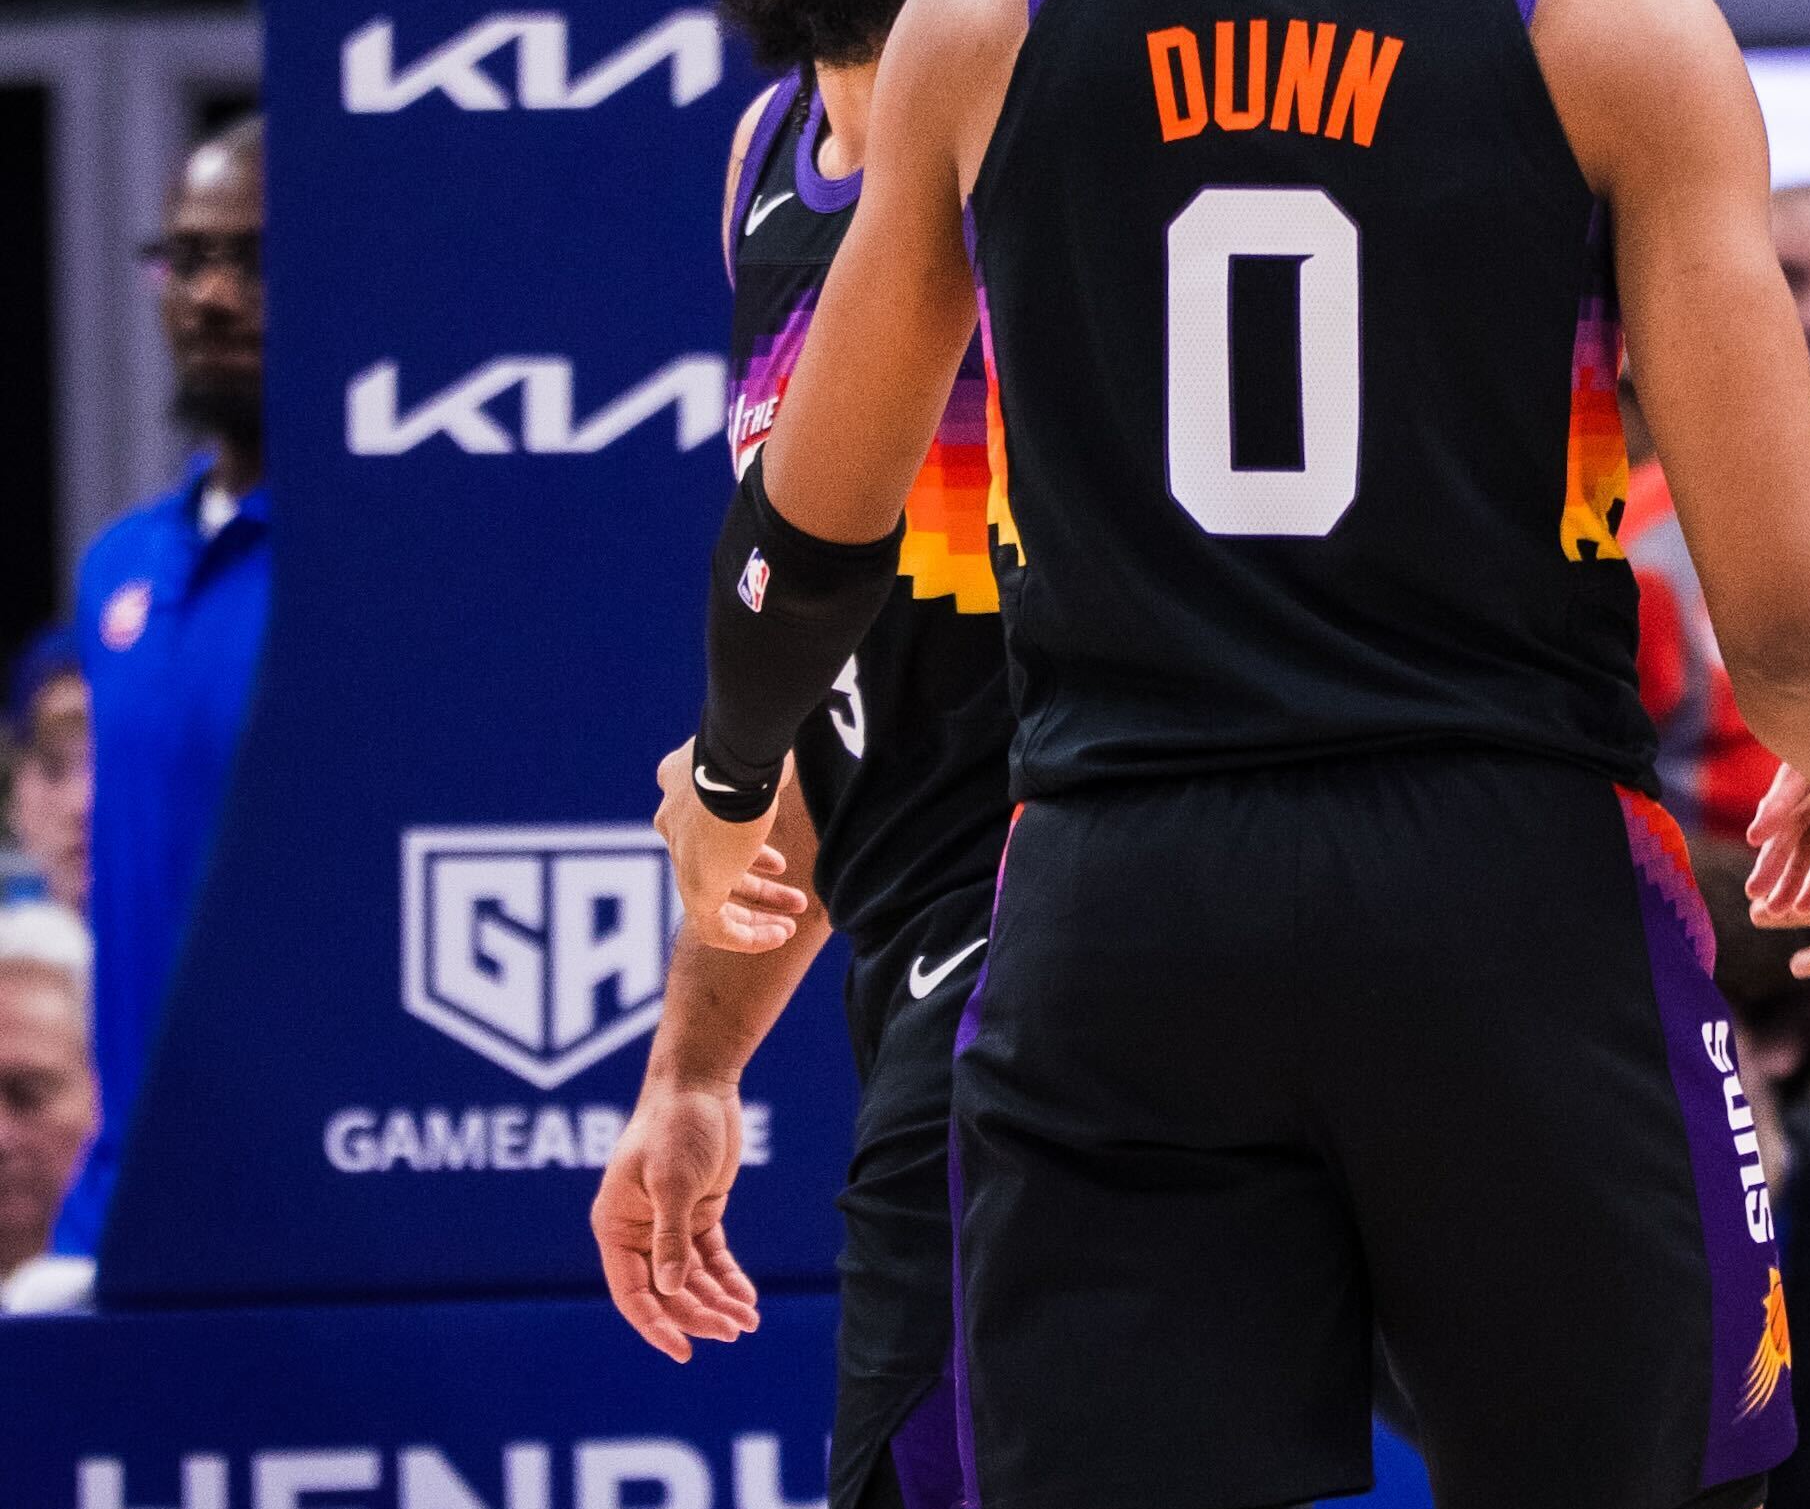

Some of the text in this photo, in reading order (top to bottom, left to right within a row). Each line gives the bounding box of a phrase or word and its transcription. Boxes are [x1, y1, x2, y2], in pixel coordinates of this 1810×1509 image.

[342, 8, 726, 114] KIA
[1146, 19, 1404, 148] DUNN
[1166, 187, 1360, 538] 0
[323, 1103, 774, 1175] GAMEABE
